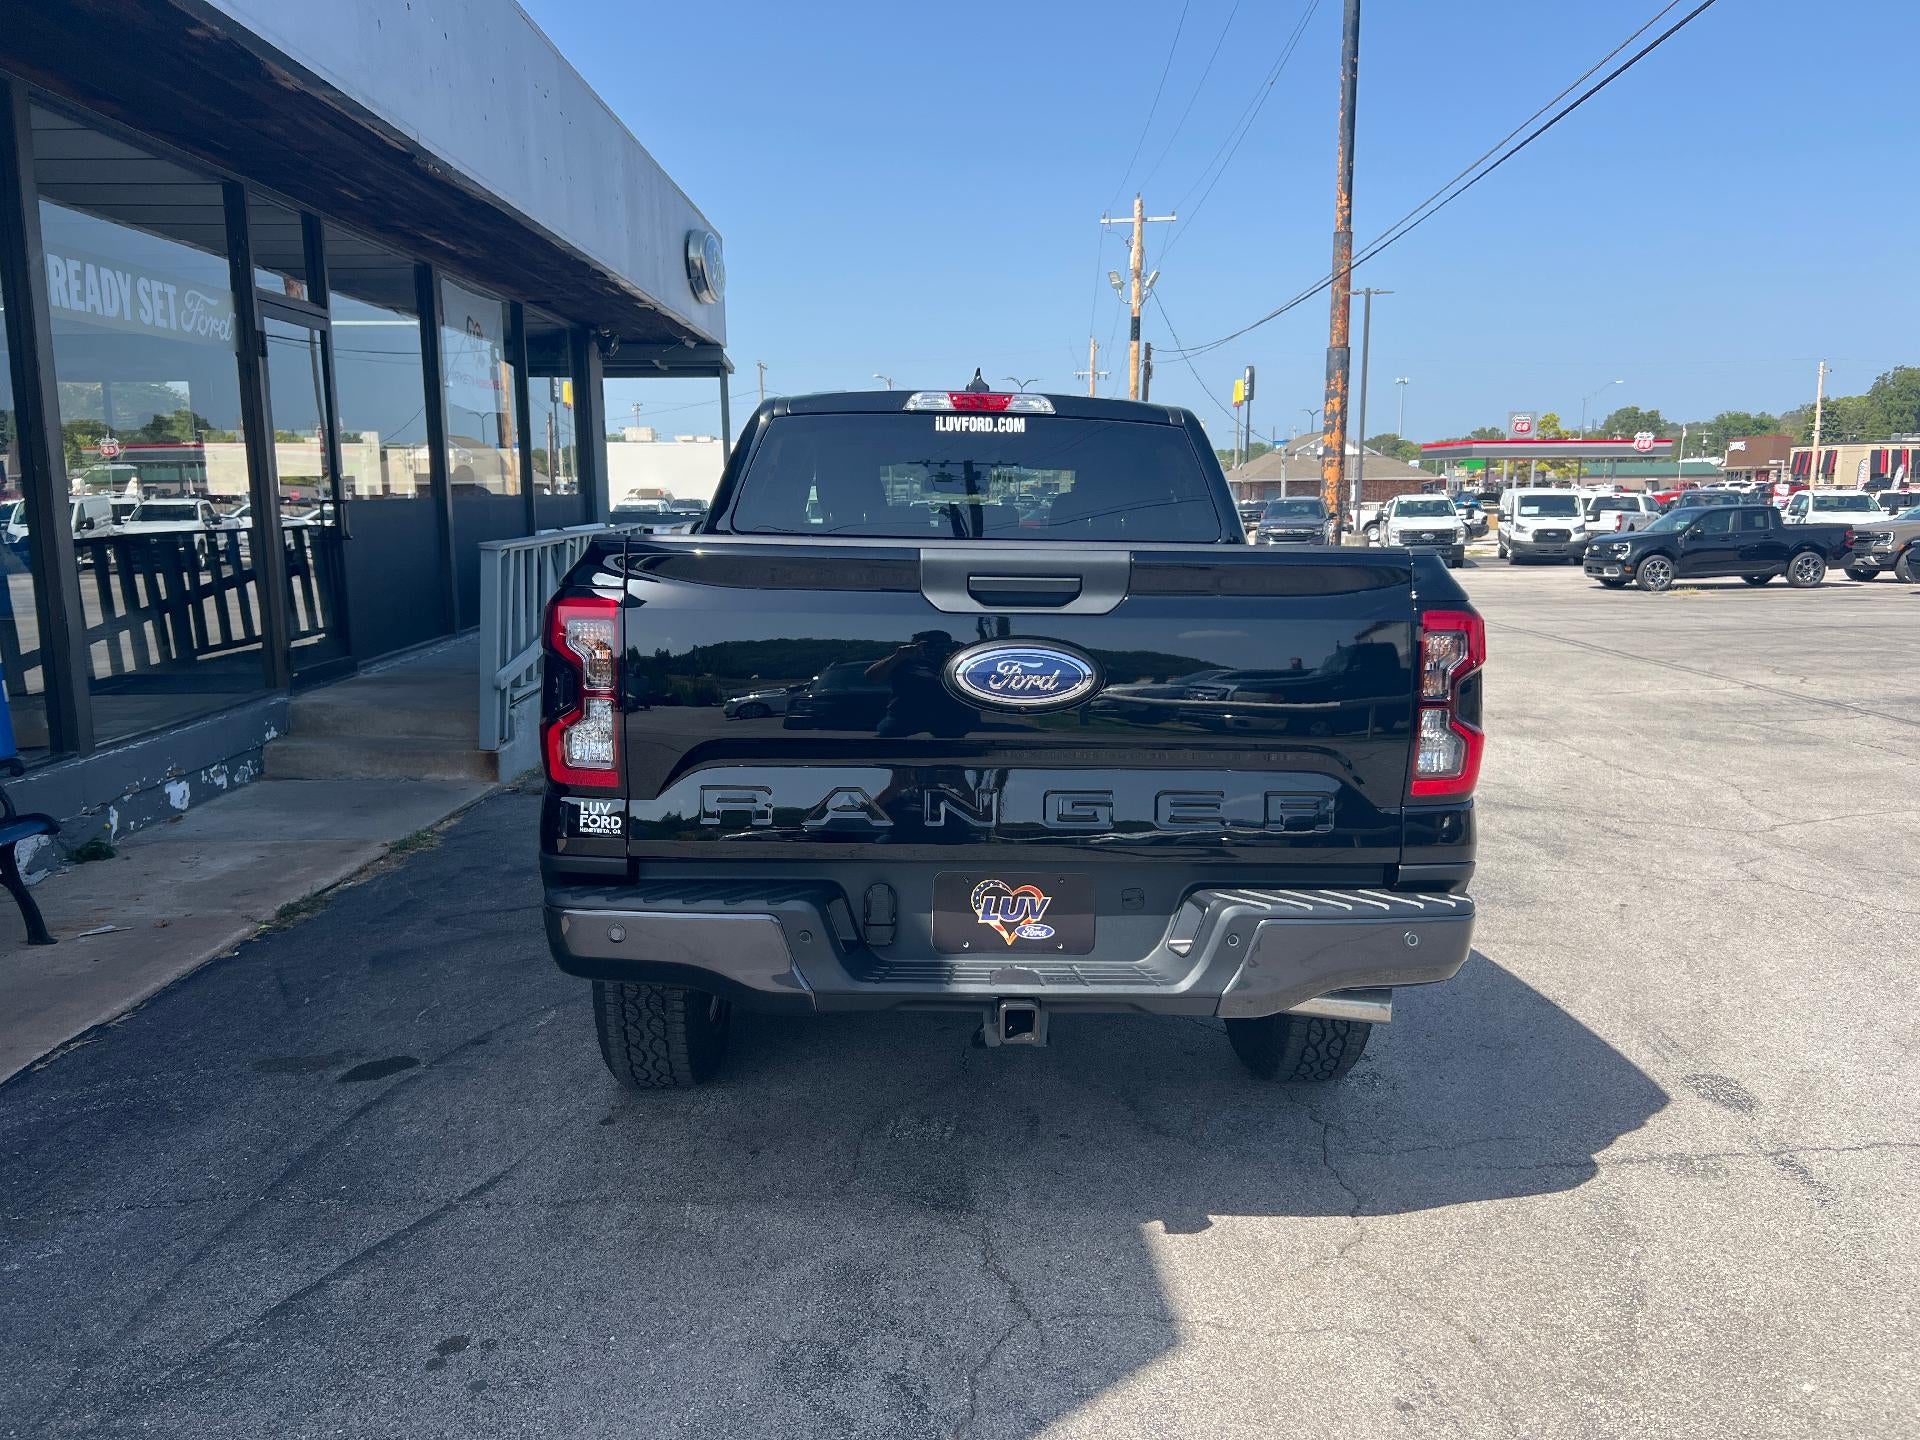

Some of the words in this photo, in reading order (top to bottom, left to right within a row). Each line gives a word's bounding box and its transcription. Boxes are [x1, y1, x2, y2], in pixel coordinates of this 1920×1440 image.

[47, 253, 131, 321] READY
[136, 276, 177, 330] SET
[180, 289, 237, 341] Ford
[988, 660, 1061, 691] Ford
[579, 814, 622, 829] FORD
[580, 801, 611, 815] LUV
[700, 785, 1335, 831] RANGER
[980, 895, 1052, 922] LUV
[1022, 925, 1047, 937] Ford
